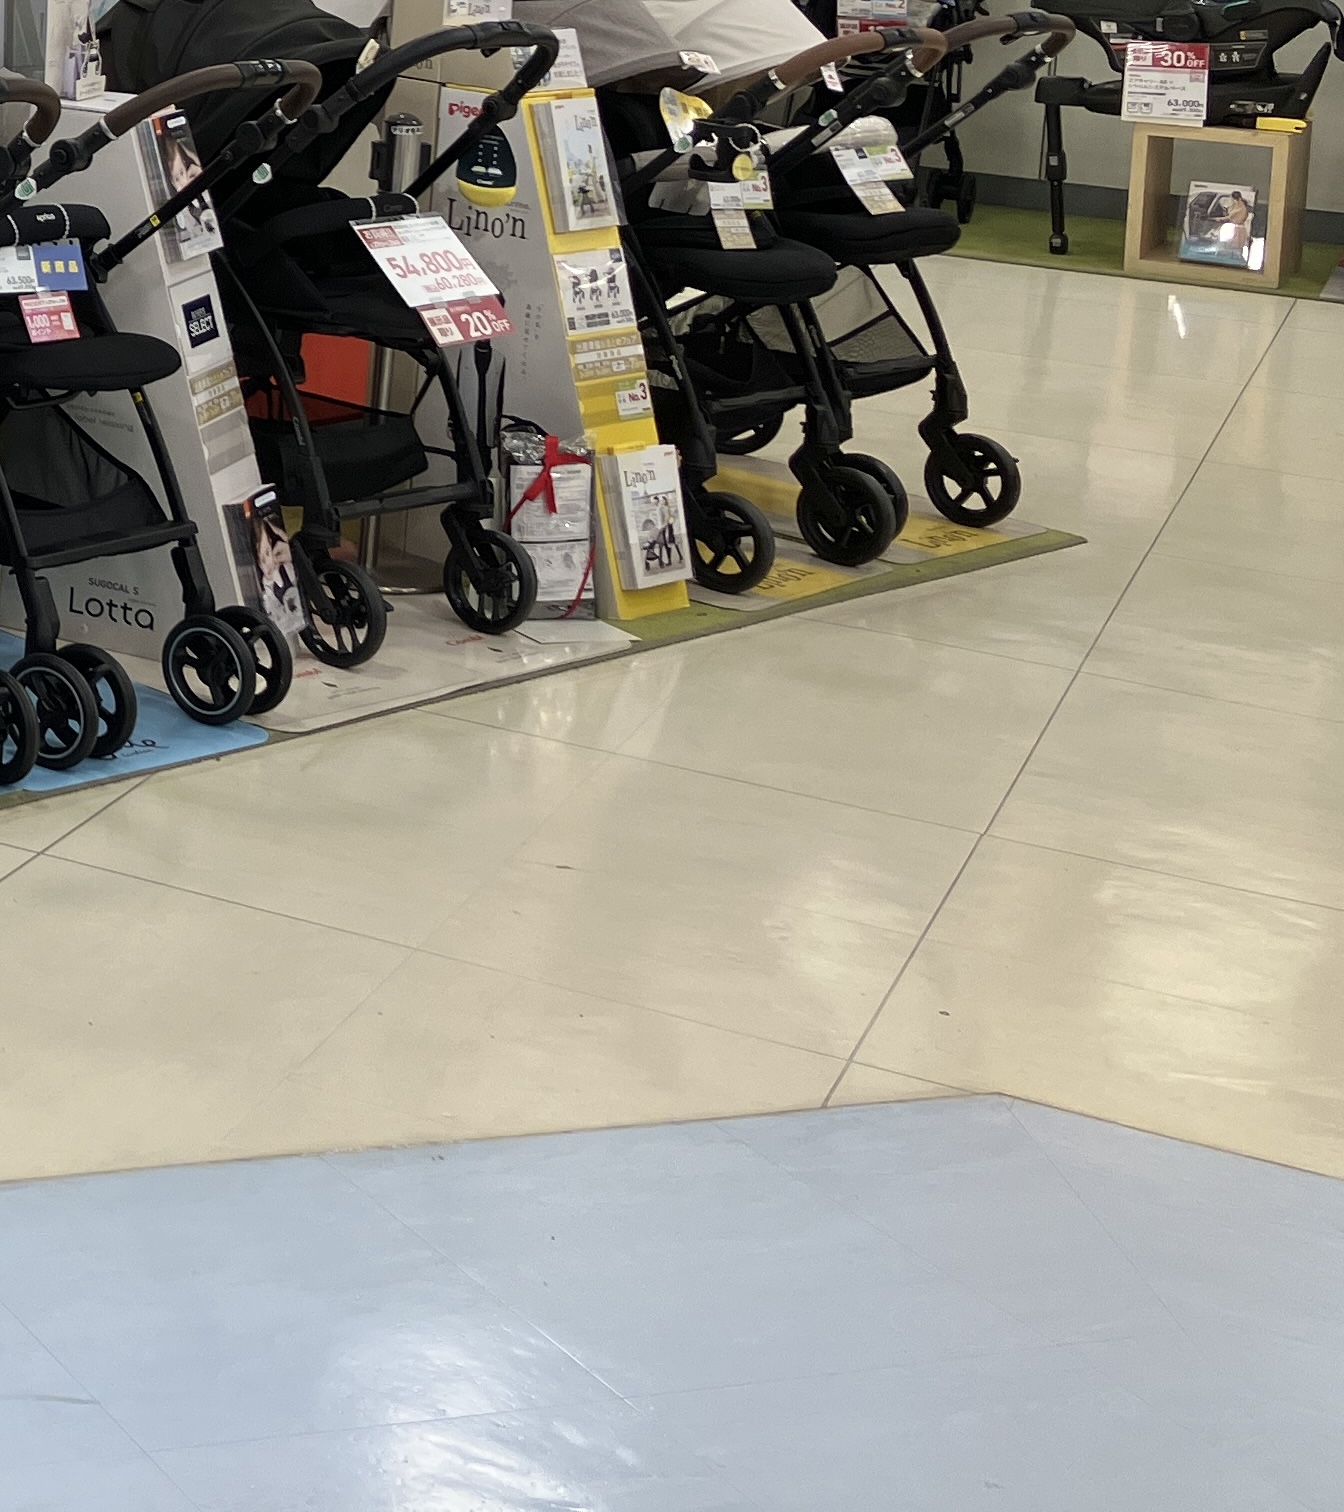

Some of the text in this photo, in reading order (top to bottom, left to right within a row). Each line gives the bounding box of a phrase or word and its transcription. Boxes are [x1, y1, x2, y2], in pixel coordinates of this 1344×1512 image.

[385, 249, 477, 279] 54,800円
[627, 381, 648, 404] No.3
[87, 576, 131, 594] SUGOCAL
[68, 586, 155, 631] Lotta
